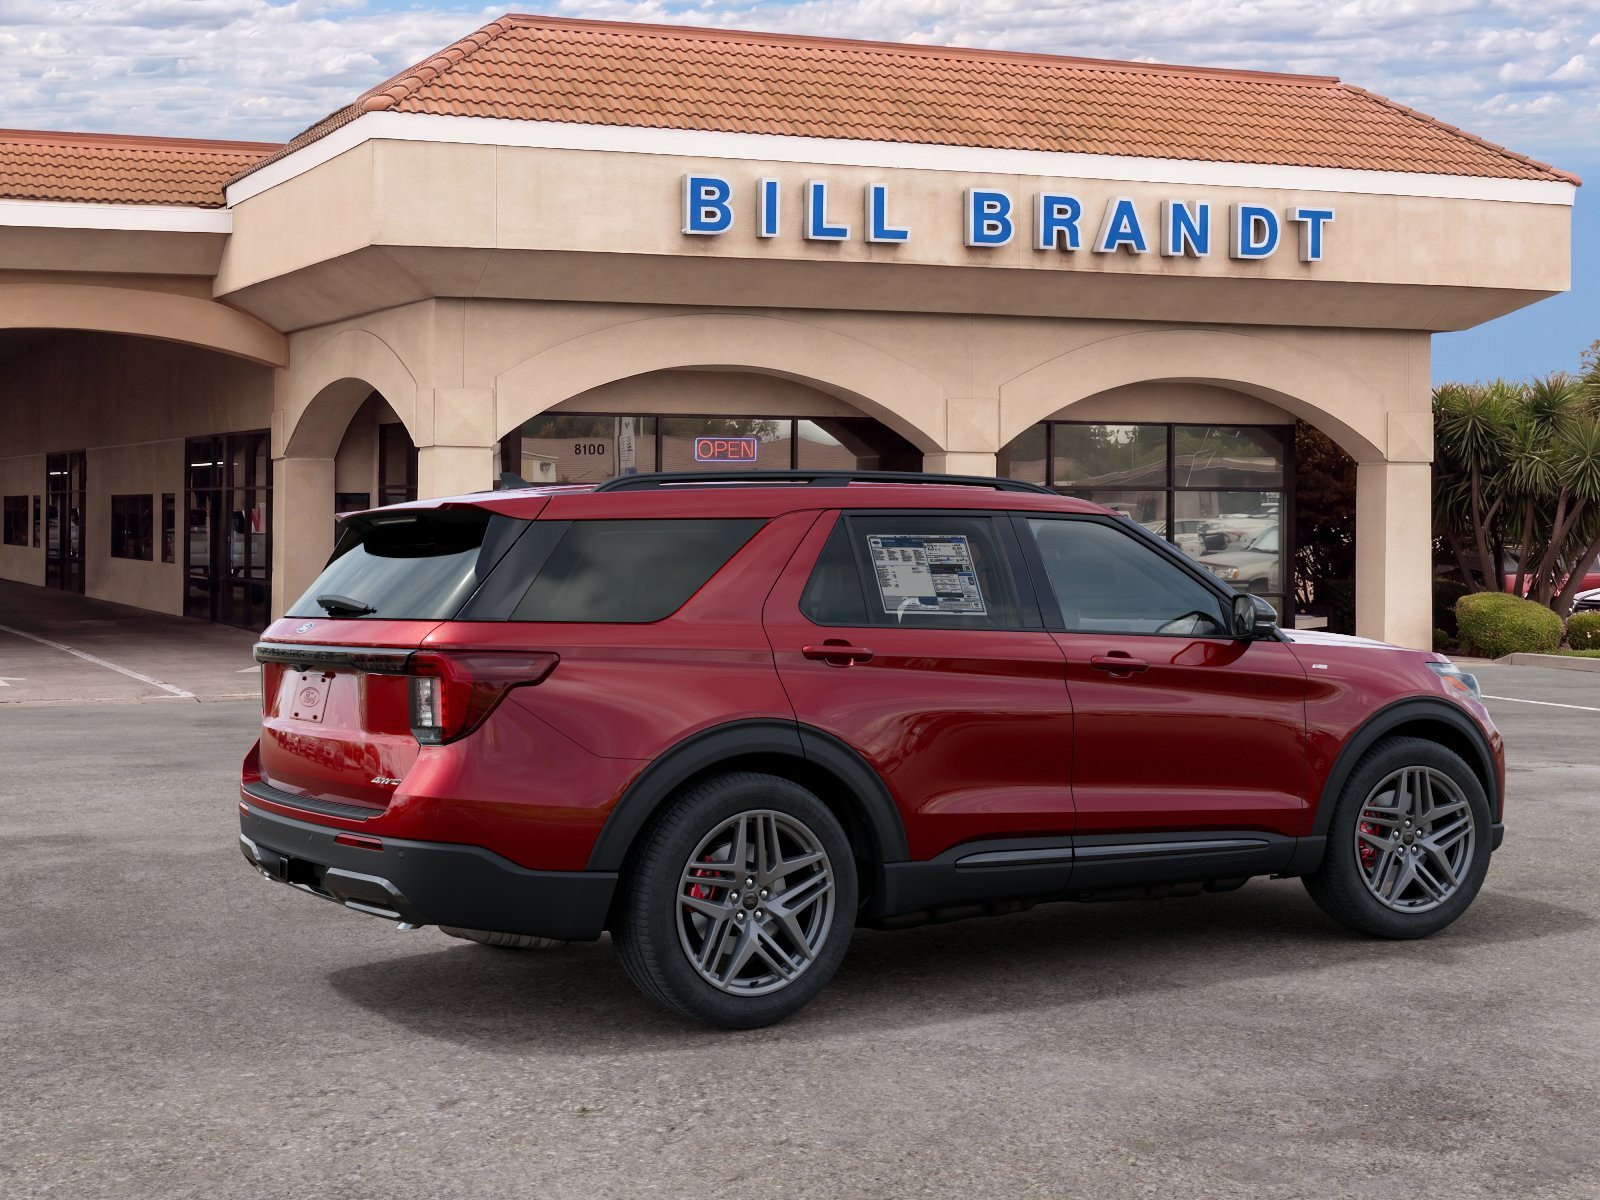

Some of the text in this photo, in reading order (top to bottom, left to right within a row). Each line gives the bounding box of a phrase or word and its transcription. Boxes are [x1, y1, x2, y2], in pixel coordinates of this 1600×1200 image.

[682, 174, 1336, 262] BILL BRANDT
[574, 443, 605, 455] 8100
[698, 440, 754, 458] OPEN
